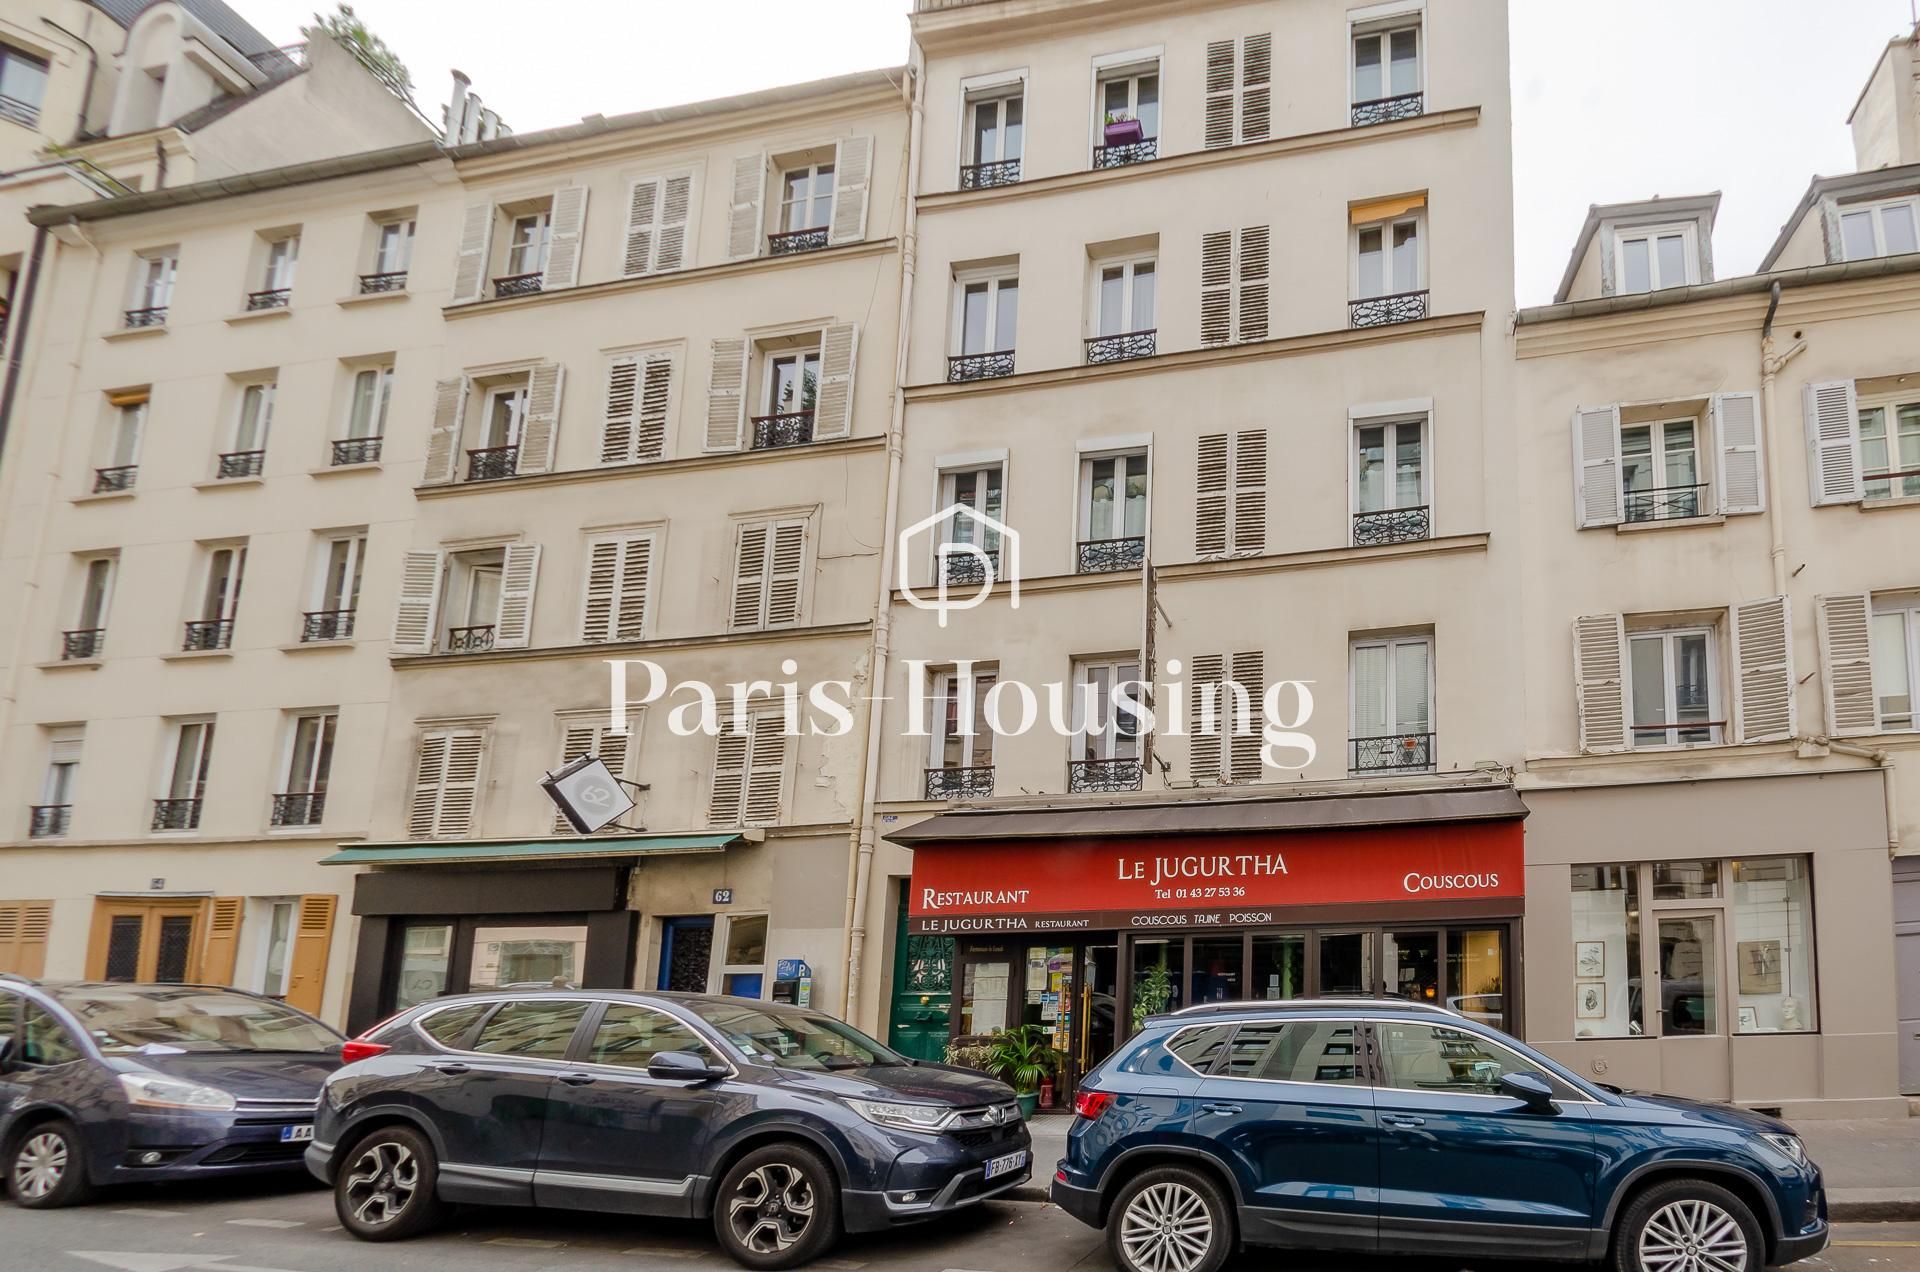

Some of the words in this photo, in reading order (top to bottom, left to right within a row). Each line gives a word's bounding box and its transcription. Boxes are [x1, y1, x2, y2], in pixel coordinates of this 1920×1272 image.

[1118, 858, 1145, 880] LE
[1150, 853, 1289, 887] JUGURTHA
[1403, 872, 1499, 893] COUSCOUS
[715, 890, 730, 902] 62
[922, 888, 1030, 910] RESTAURANT
[1155, 889, 1171, 899] Tel
[1176, 889, 1187, 899] 01
[1190, 888, 1202, 898] 43
[1204, 888, 1216, 897] 27
[1218, 887, 1231, 897] 53
[1233, 887, 1245, 896] 36
[922, 919, 939, 931] LE
[941, 917, 1028, 933] JUGURTHA
[1035, 919, 1090, 928] RESTAURANT
[1131, 915, 1188, 926] COUSCOUS
[1194, 913, 1221, 925] TAJINE
[1229, 912, 1273, 923] POISSON
